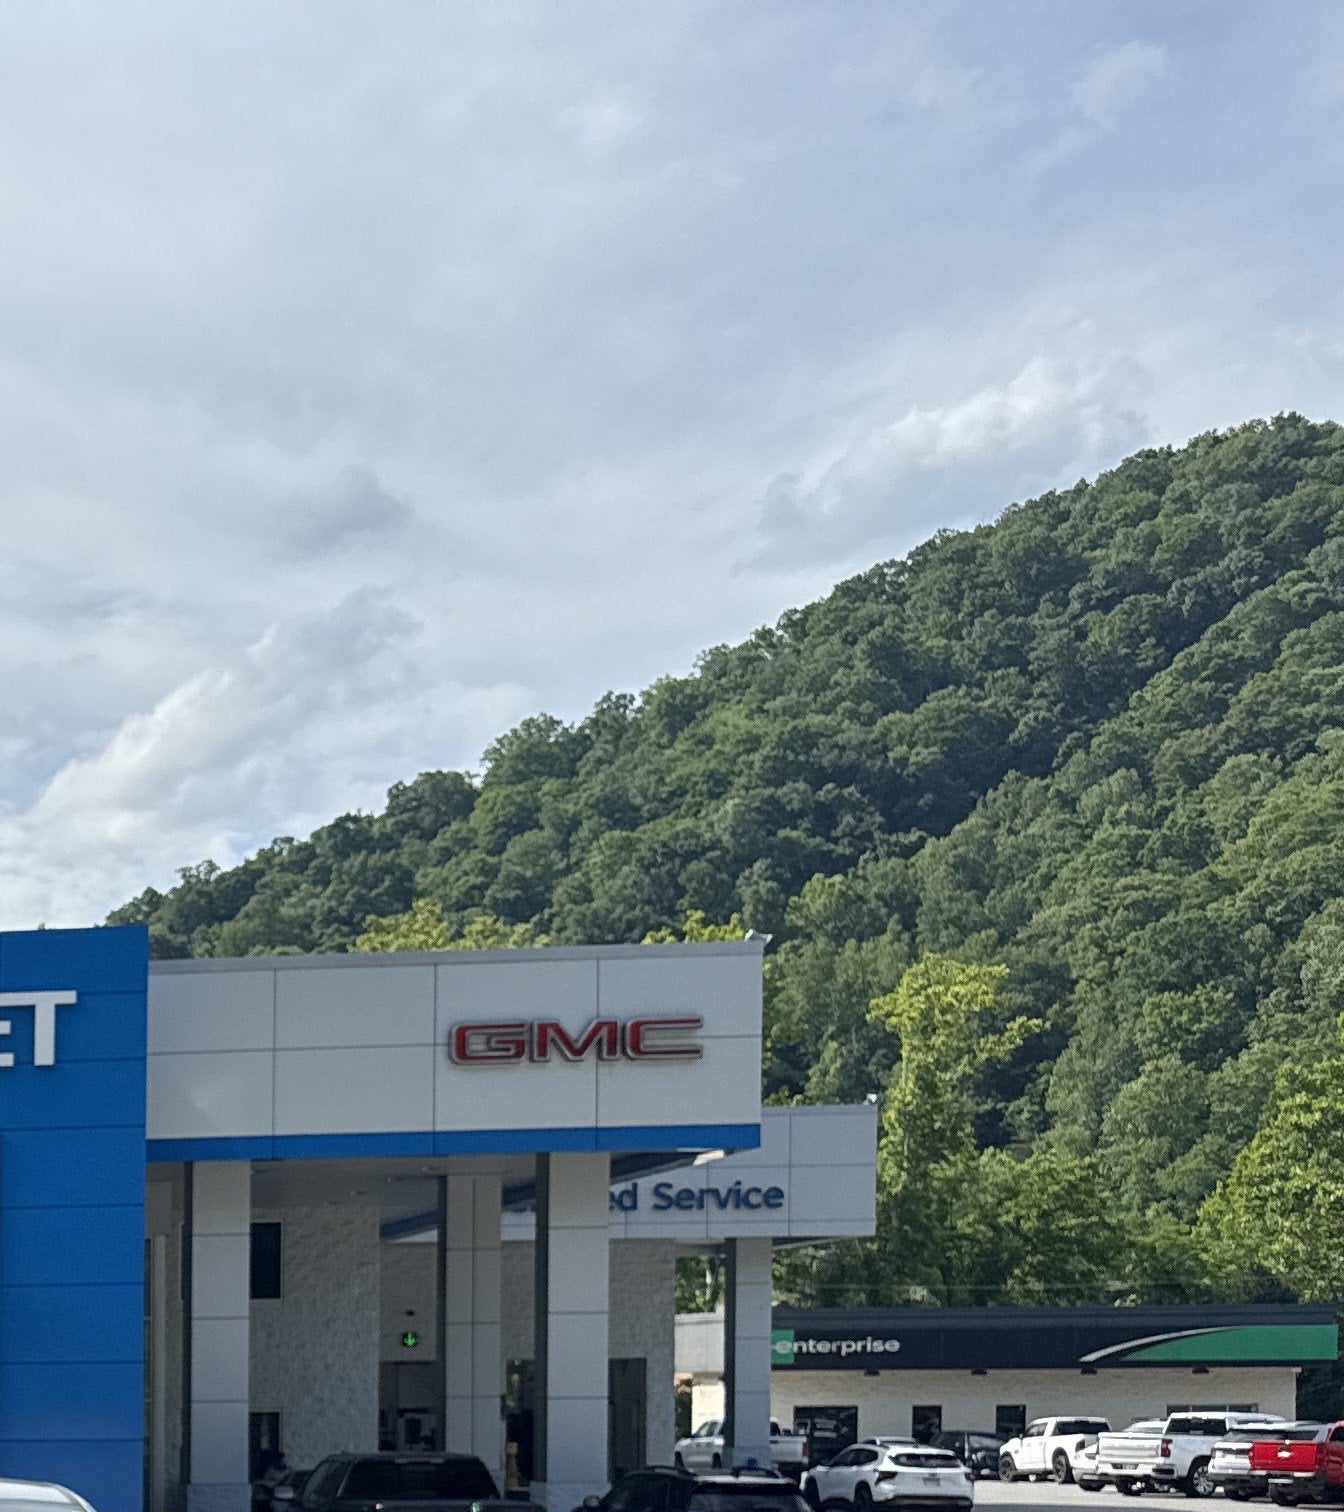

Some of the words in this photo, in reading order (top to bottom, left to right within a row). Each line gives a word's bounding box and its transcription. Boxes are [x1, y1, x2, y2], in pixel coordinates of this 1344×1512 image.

[450, 1016, 704, 1065] GMC
[651, 1180, 785, 1211] Service
[773, 1336, 900, 1357] enterprise
